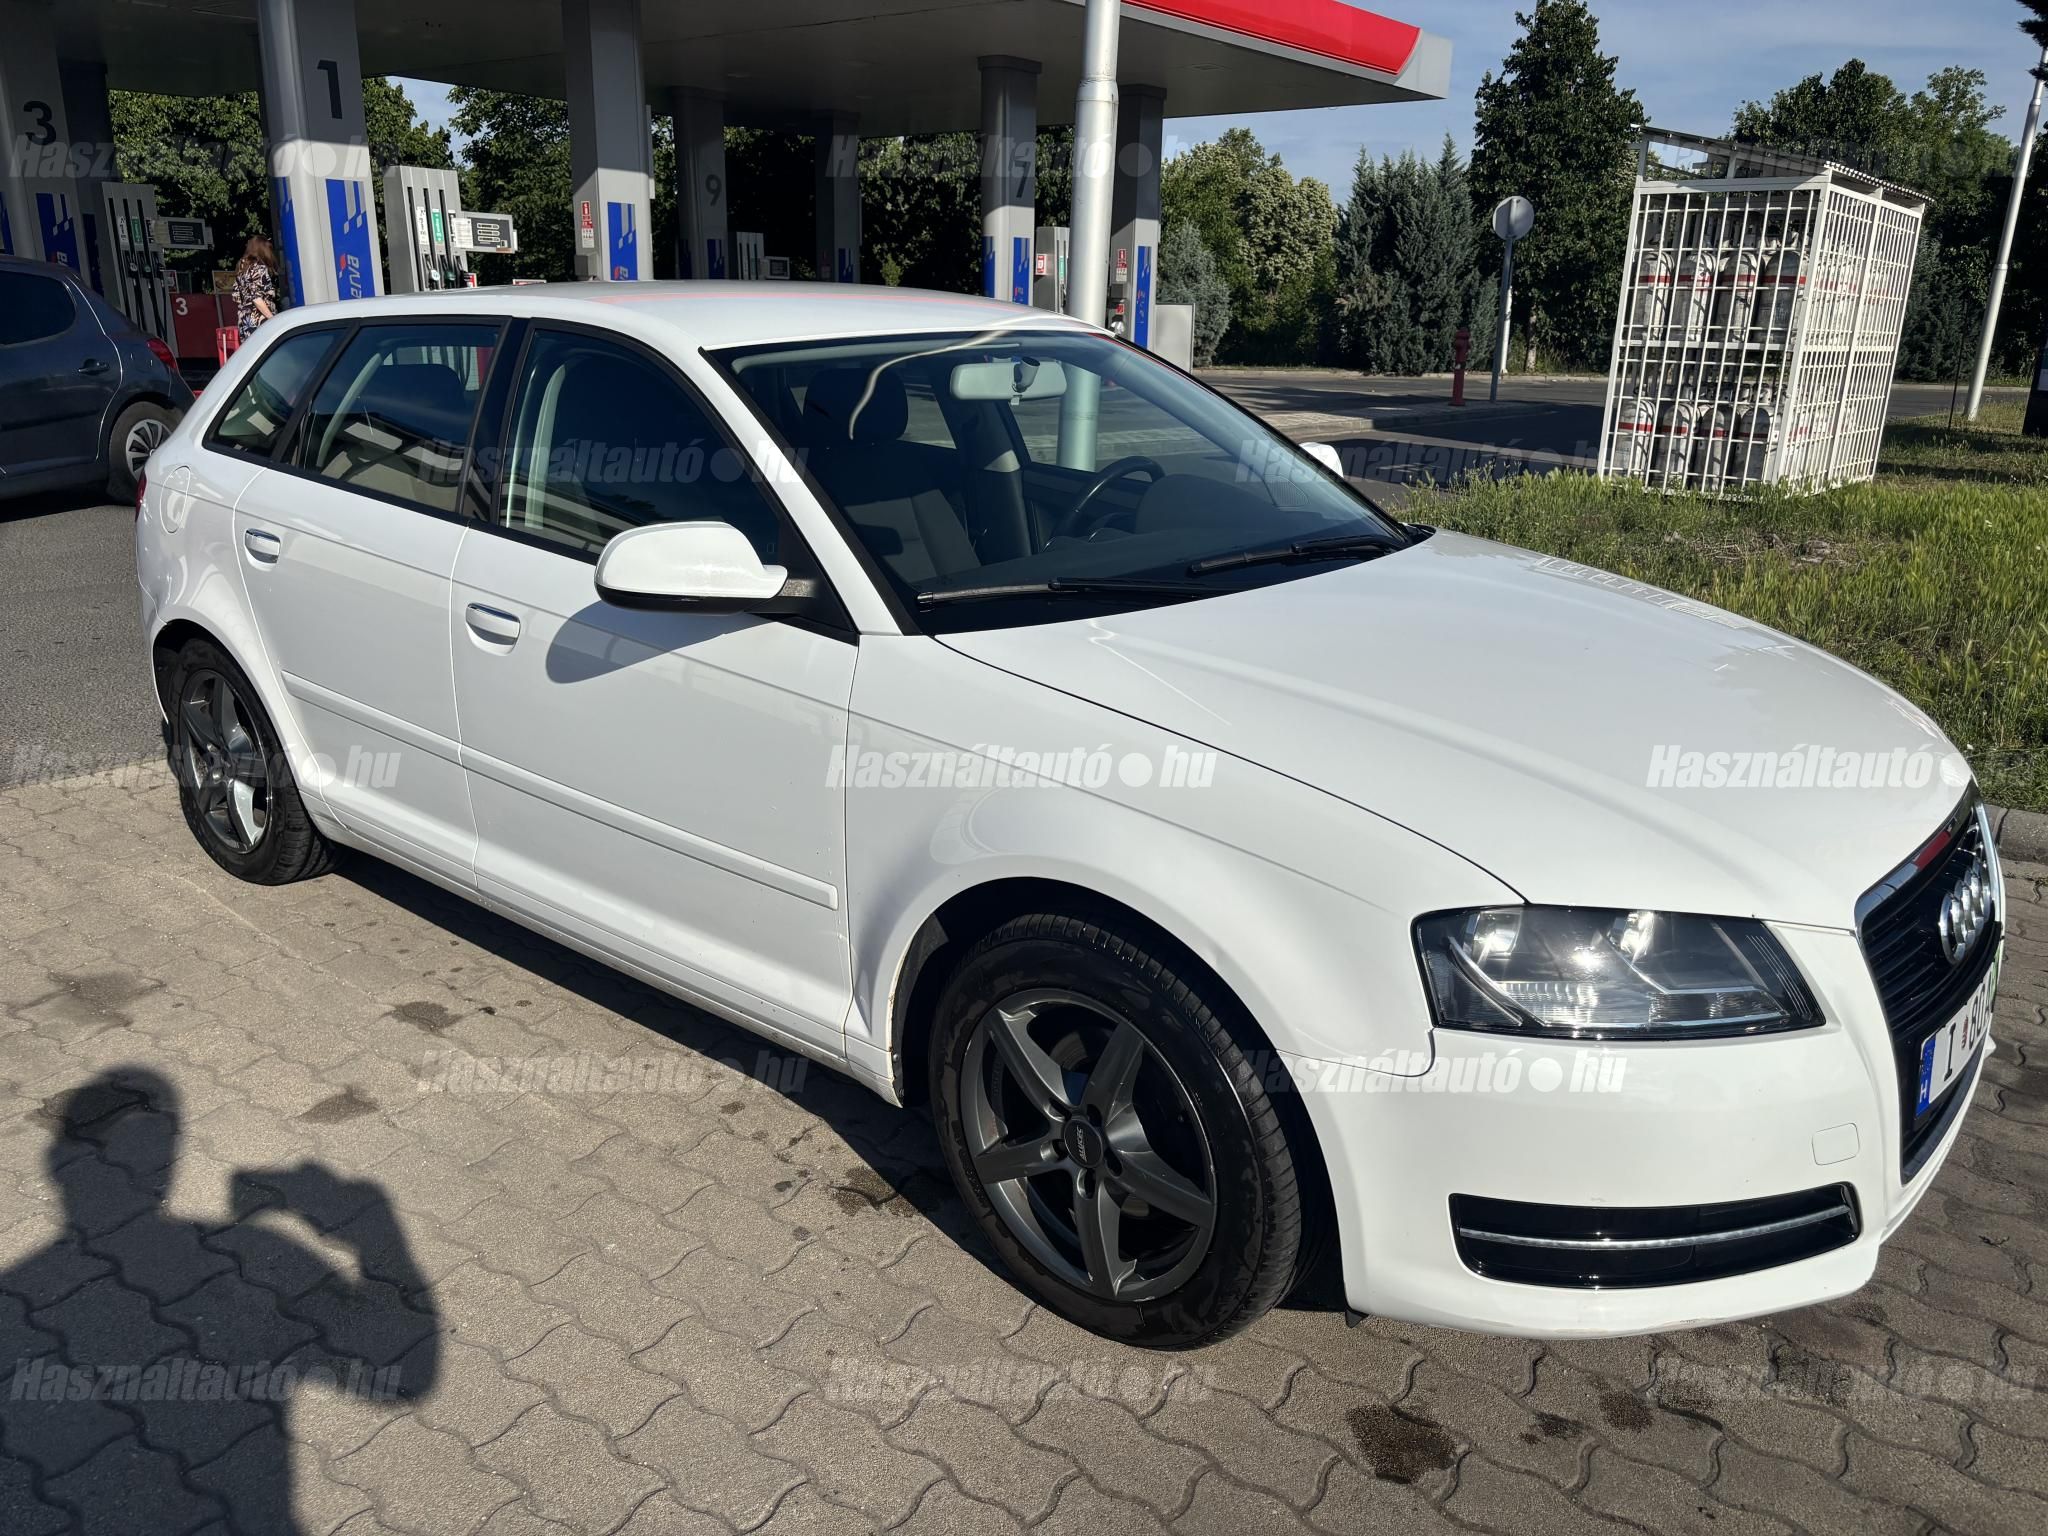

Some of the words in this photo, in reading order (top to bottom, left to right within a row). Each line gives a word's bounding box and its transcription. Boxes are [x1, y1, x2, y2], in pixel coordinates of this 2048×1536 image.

[317, 59, 343, 120] 1
[23, 100, 57, 146] 3
[705, 173, 721, 206] 9
[1014, 159, 1031, 198] 7
[175, 297, 189, 316] 3
